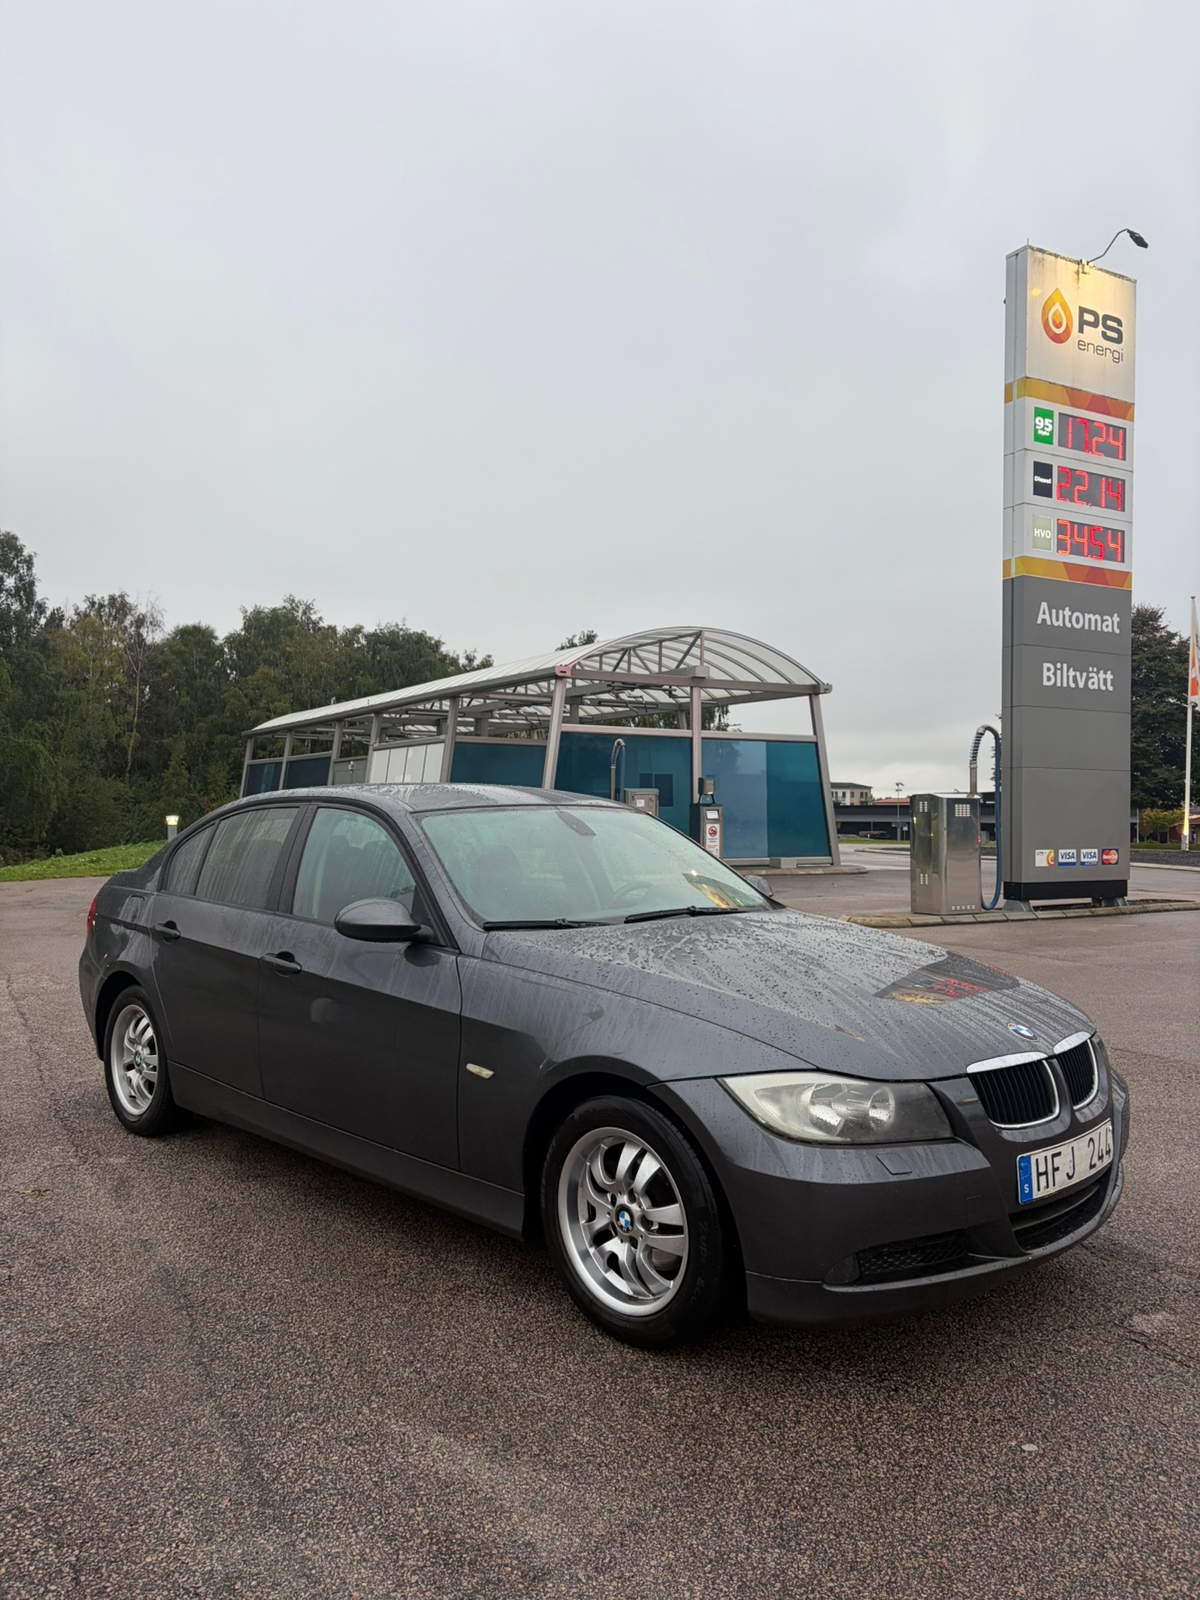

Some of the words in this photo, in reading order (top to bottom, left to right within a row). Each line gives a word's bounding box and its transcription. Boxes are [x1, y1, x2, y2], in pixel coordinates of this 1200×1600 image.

[1077, 305, 1123, 345] PS
[1077, 339, 1123, 364] energi
[1035, 416, 1053, 432] 95
[1034, 475, 1052, 484] Diesel
[1034, 528, 1052, 539] HVO
[1036, 601, 1120, 634] Automat
[1042, 662, 1114, 691] Biltvätt
[1060, 852, 1075, 860] VISA
[1082, 851, 1097, 859] VISA
[1035, 1145, 1076, 1192] HFJ
[1087, 1127, 1111, 1170] 244
[1024, 1184, 1029, 1193] S
